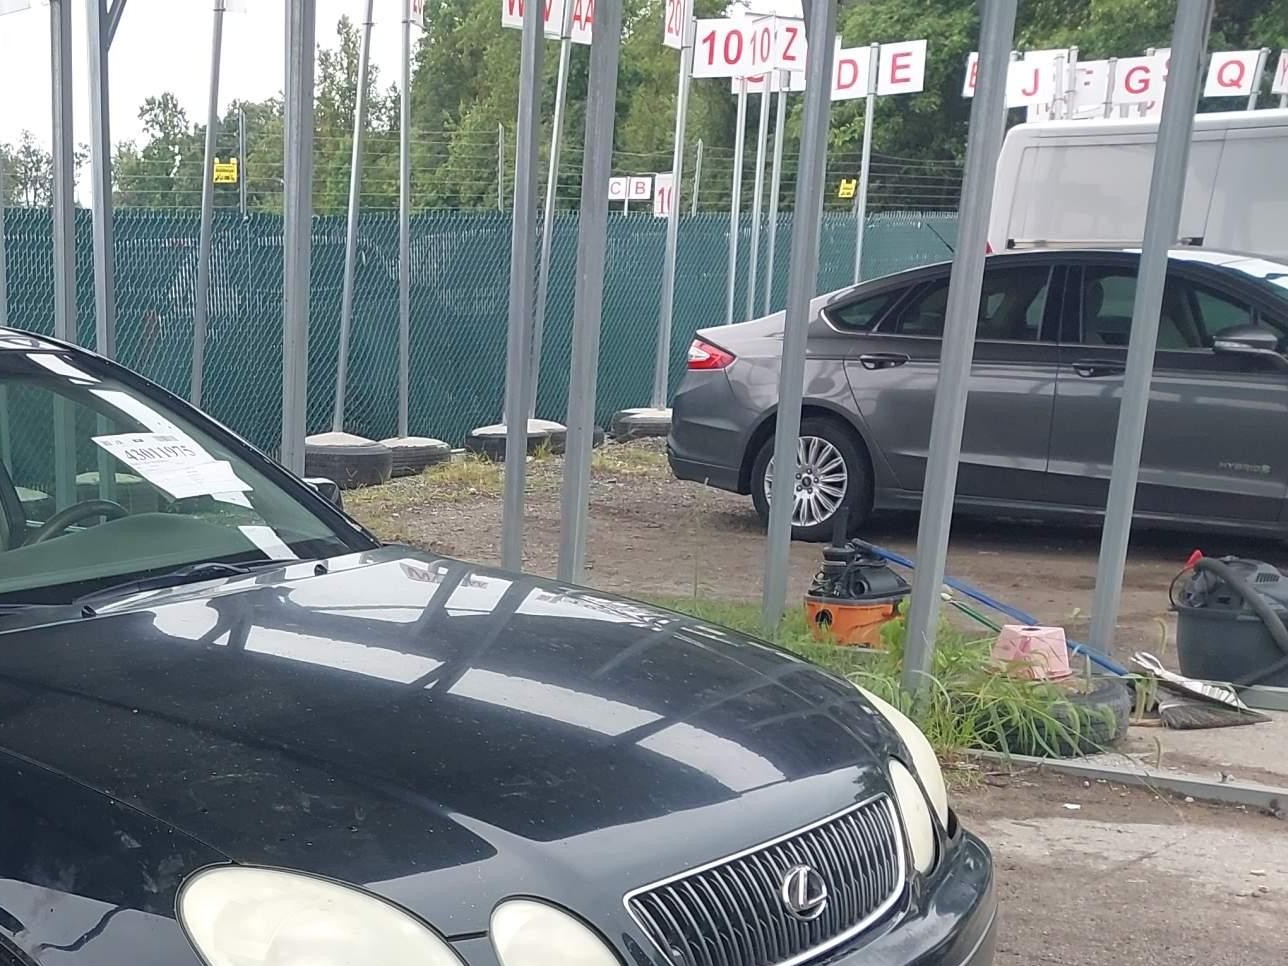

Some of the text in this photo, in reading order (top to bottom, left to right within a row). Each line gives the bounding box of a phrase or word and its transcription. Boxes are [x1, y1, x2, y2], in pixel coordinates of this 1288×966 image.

[702, 29, 743, 66] 10
[782, 27, 798, 61] Z
[838, 59, 858, 90] D
[891, 52, 912, 84] E
[1022, 68, 1040, 97] J
[1124, 66, 1150, 94] G
[1217, 60, 1245, 89] Q
[610, 181, 621, 195] C
[634, 181, 646, 195] B
[123, 445, 196, 462] 43011975
